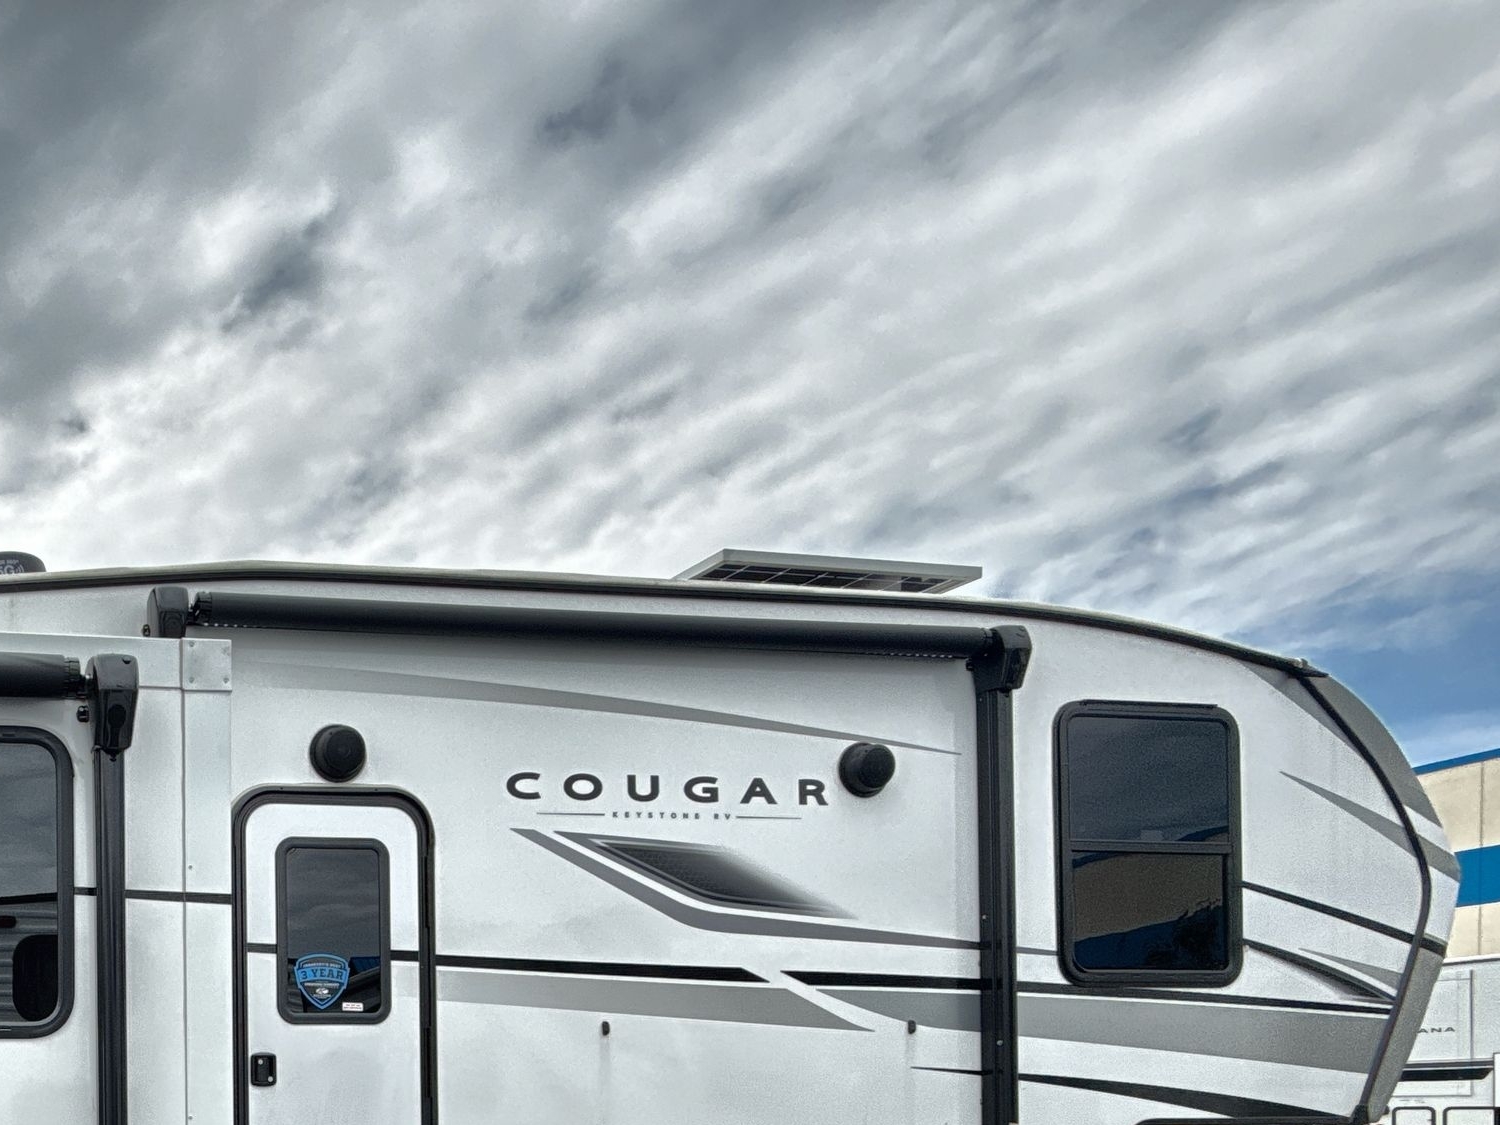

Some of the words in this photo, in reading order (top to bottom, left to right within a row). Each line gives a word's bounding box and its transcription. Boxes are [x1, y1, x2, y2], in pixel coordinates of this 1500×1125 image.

[506, 771, 829, 806] COUGAR
[612, 811, 701, 820] KEYSTONE
[713, 812, 732, 821] RV
[300, 970, 308, 980] 3
[311, 968, 344, 981] YEAR
